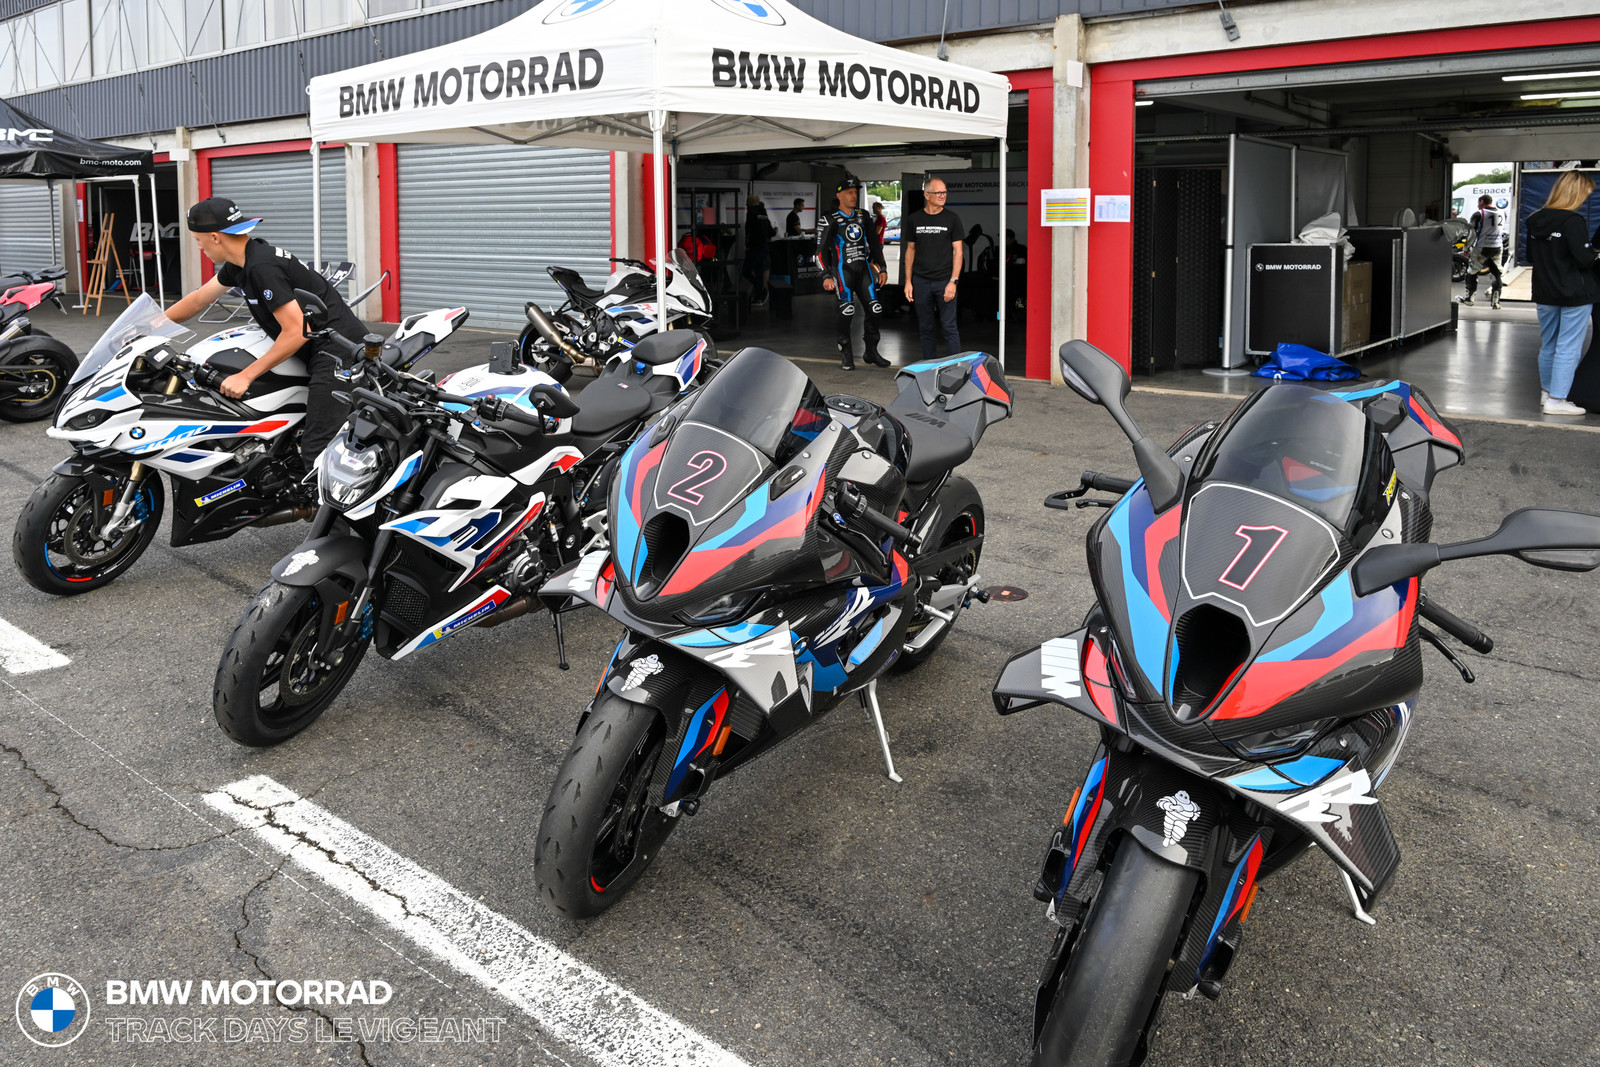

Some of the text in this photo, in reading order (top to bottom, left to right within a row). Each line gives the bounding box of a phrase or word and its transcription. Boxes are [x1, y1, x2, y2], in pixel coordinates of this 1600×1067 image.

[339, 48, 604, 118] BMW MOTORRAD
[712, 47, 980, 114] BMW MOTORRAD
[79, 158, 142, 166] bmc-moto.com
[1472, 187, 1507, 195] Espace
[1488, 214, 1504, 227] 12
[667, 449, 728, 506] 2
[211, 483, 241, 500] MICHELIN
[1217, 524, 1290, 591] 1
[453, 605, 490, 628] MICHELIN
